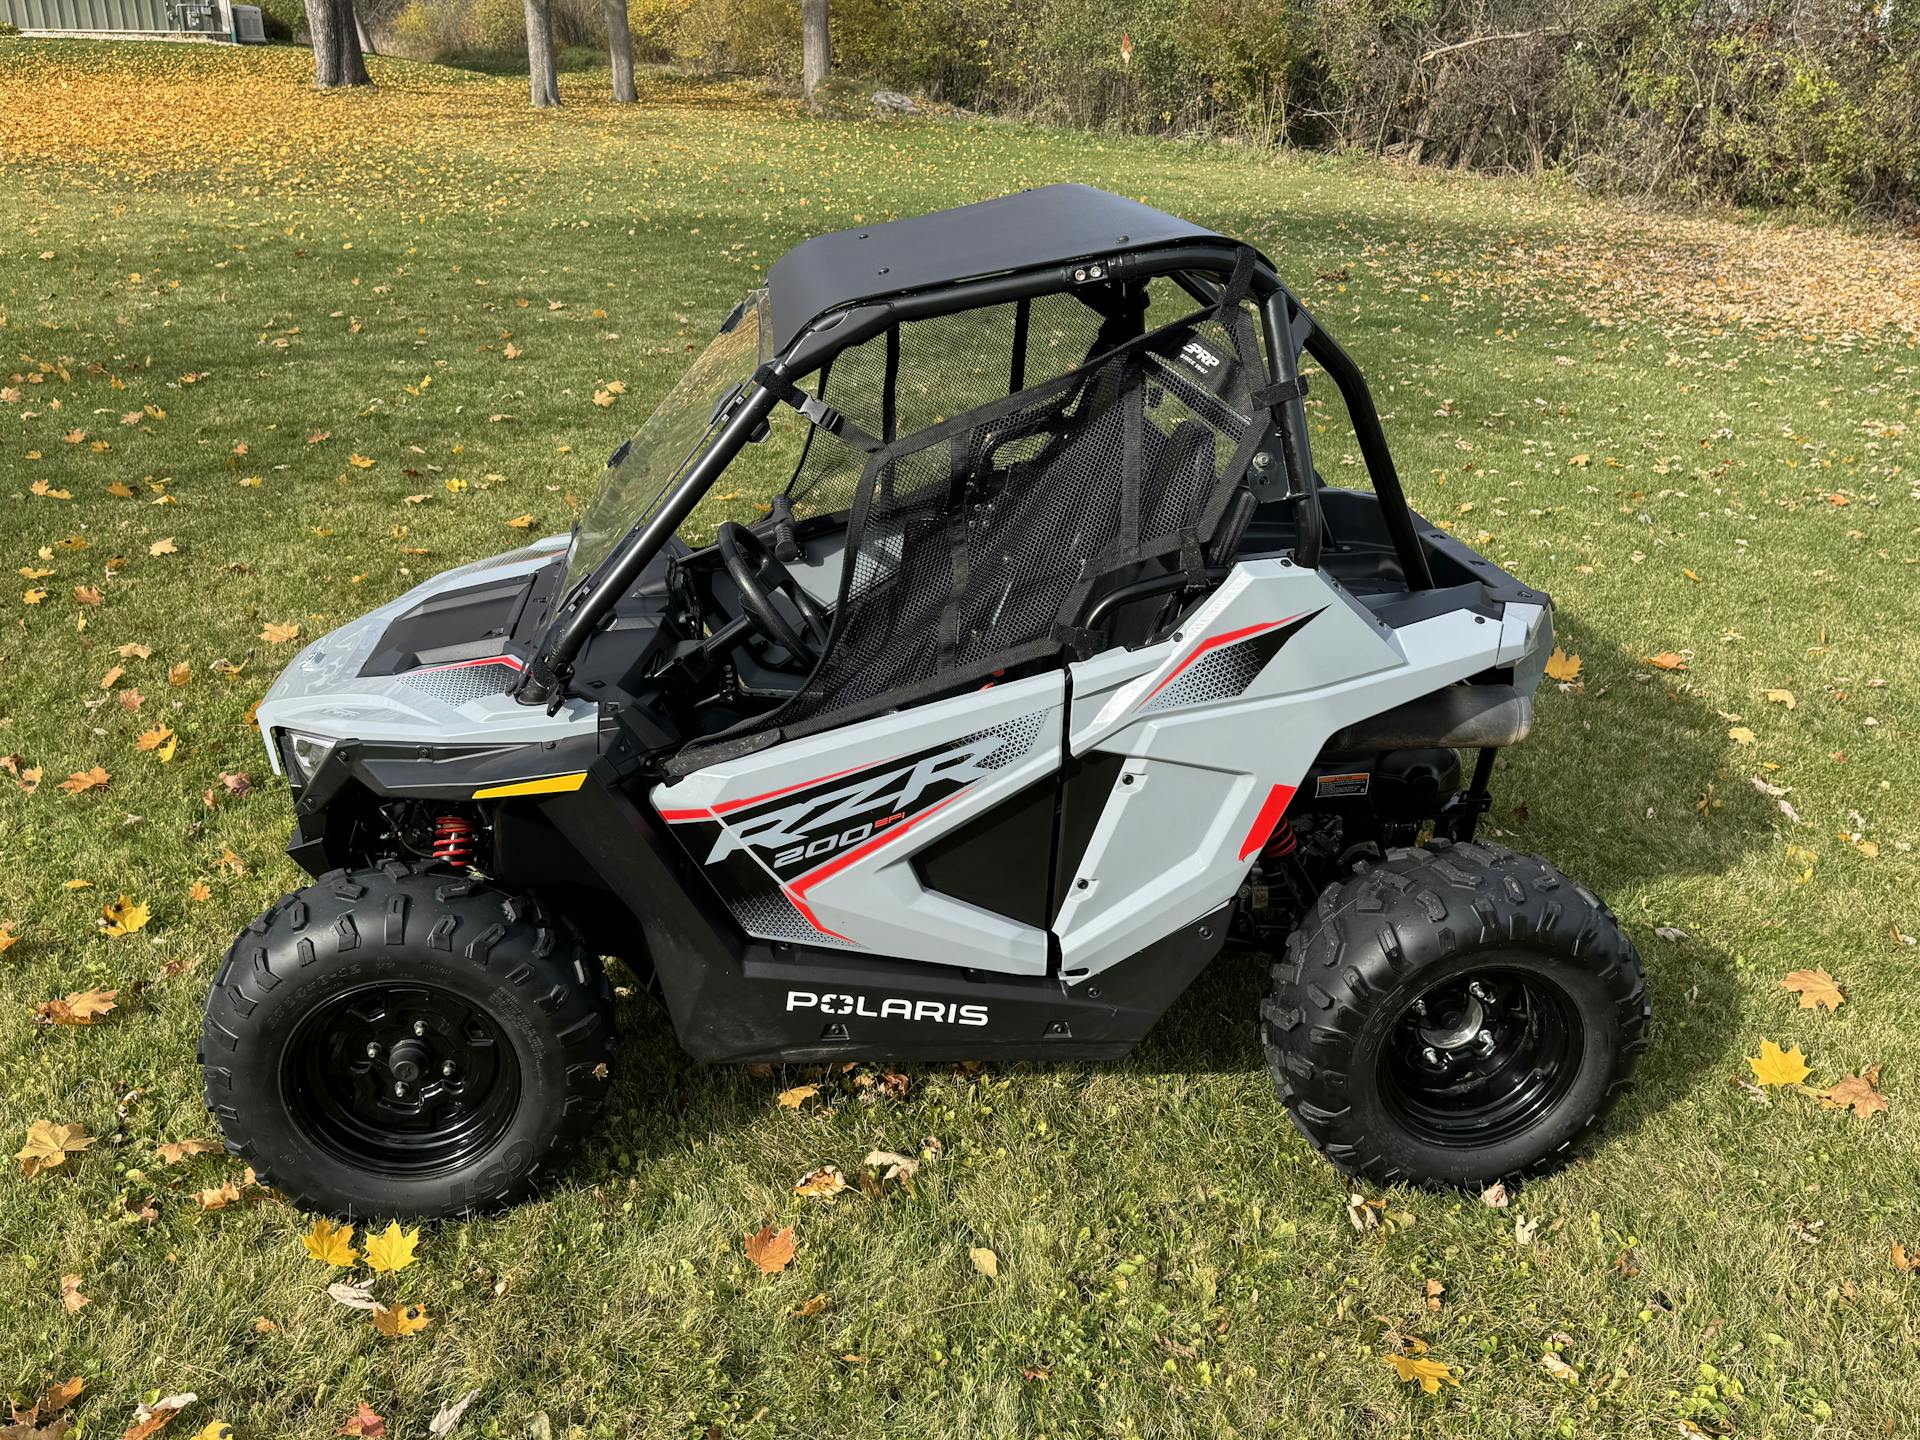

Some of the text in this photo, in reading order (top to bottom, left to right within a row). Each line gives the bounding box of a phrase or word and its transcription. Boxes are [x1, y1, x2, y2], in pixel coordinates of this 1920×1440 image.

[1180, 353, 1196, 365] SINCE
[1184, 342, 1220, 366] PRP
[704, 735, 1007, 866] RZR
[774, 812, 905, 868] 200 EFI
[786, 990, 989, 1026] POLARIS
